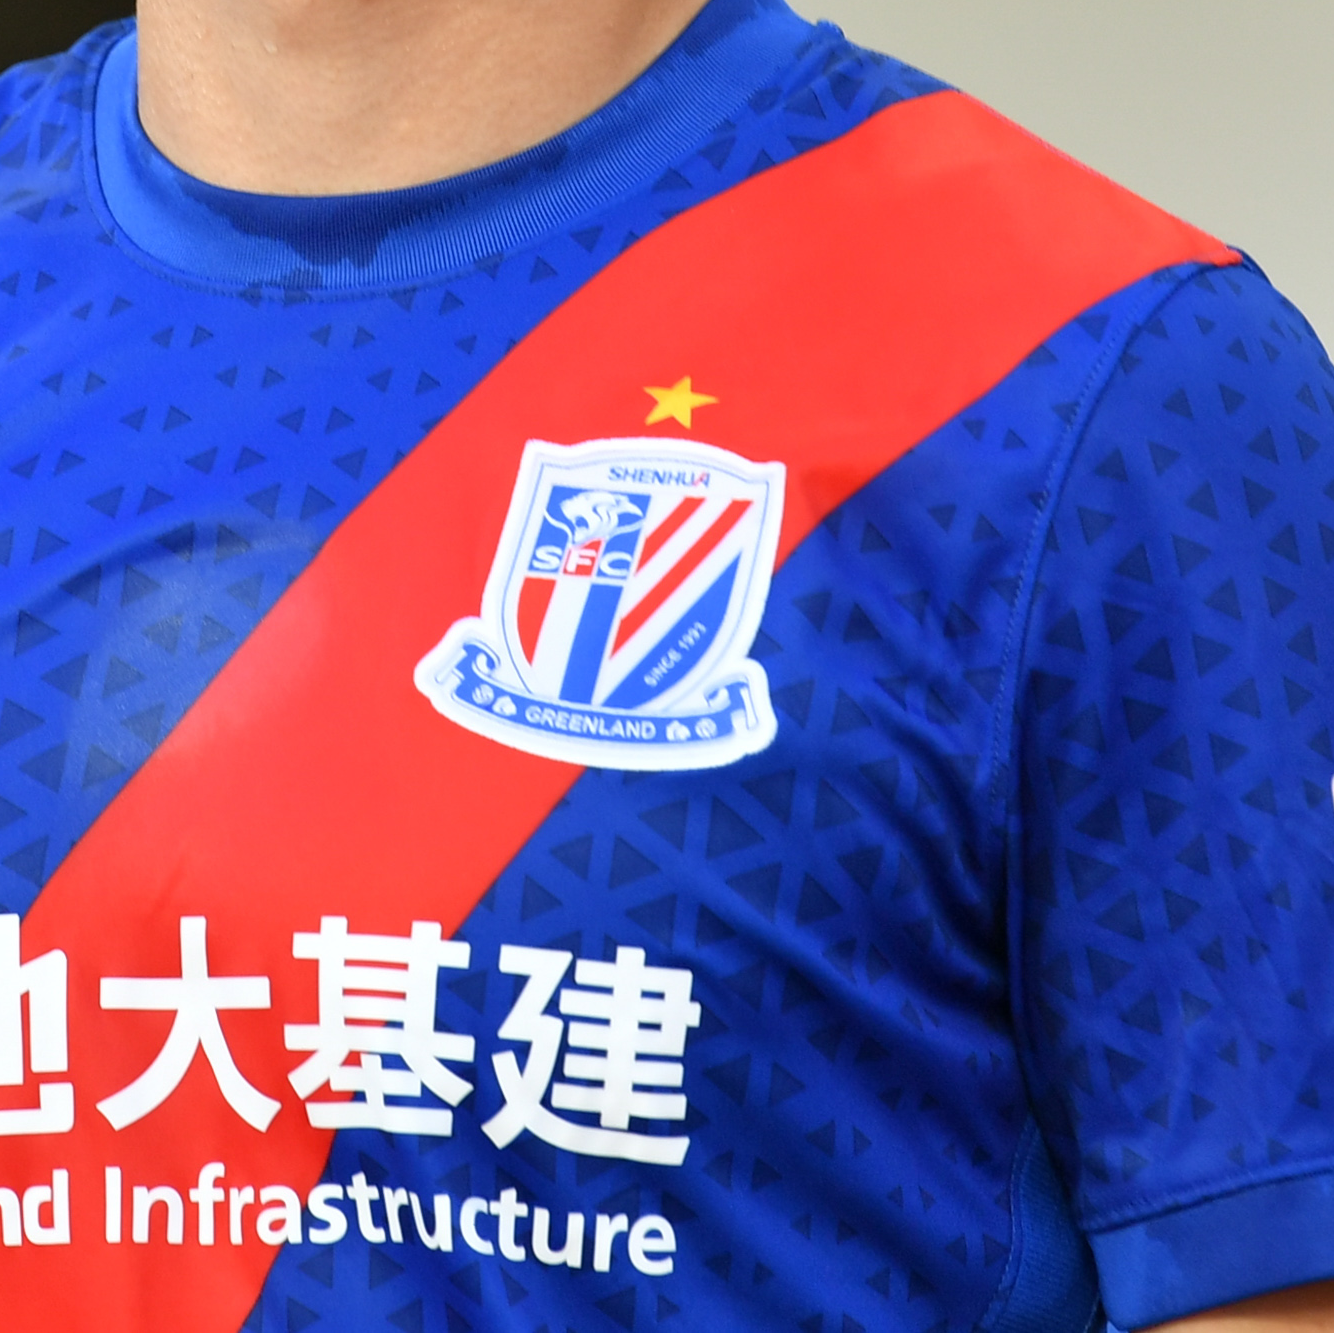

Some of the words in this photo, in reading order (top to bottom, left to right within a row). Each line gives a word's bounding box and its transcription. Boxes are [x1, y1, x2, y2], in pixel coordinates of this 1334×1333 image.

[607, 466, 710, 488] SHENHUA
[531, 544, 633, 577] SFC
[643, 648, 682, 687] SINCE
[525, 705, 656, 741] GREENLAND
[104, 1161, 677, 1276] Infrastructure
